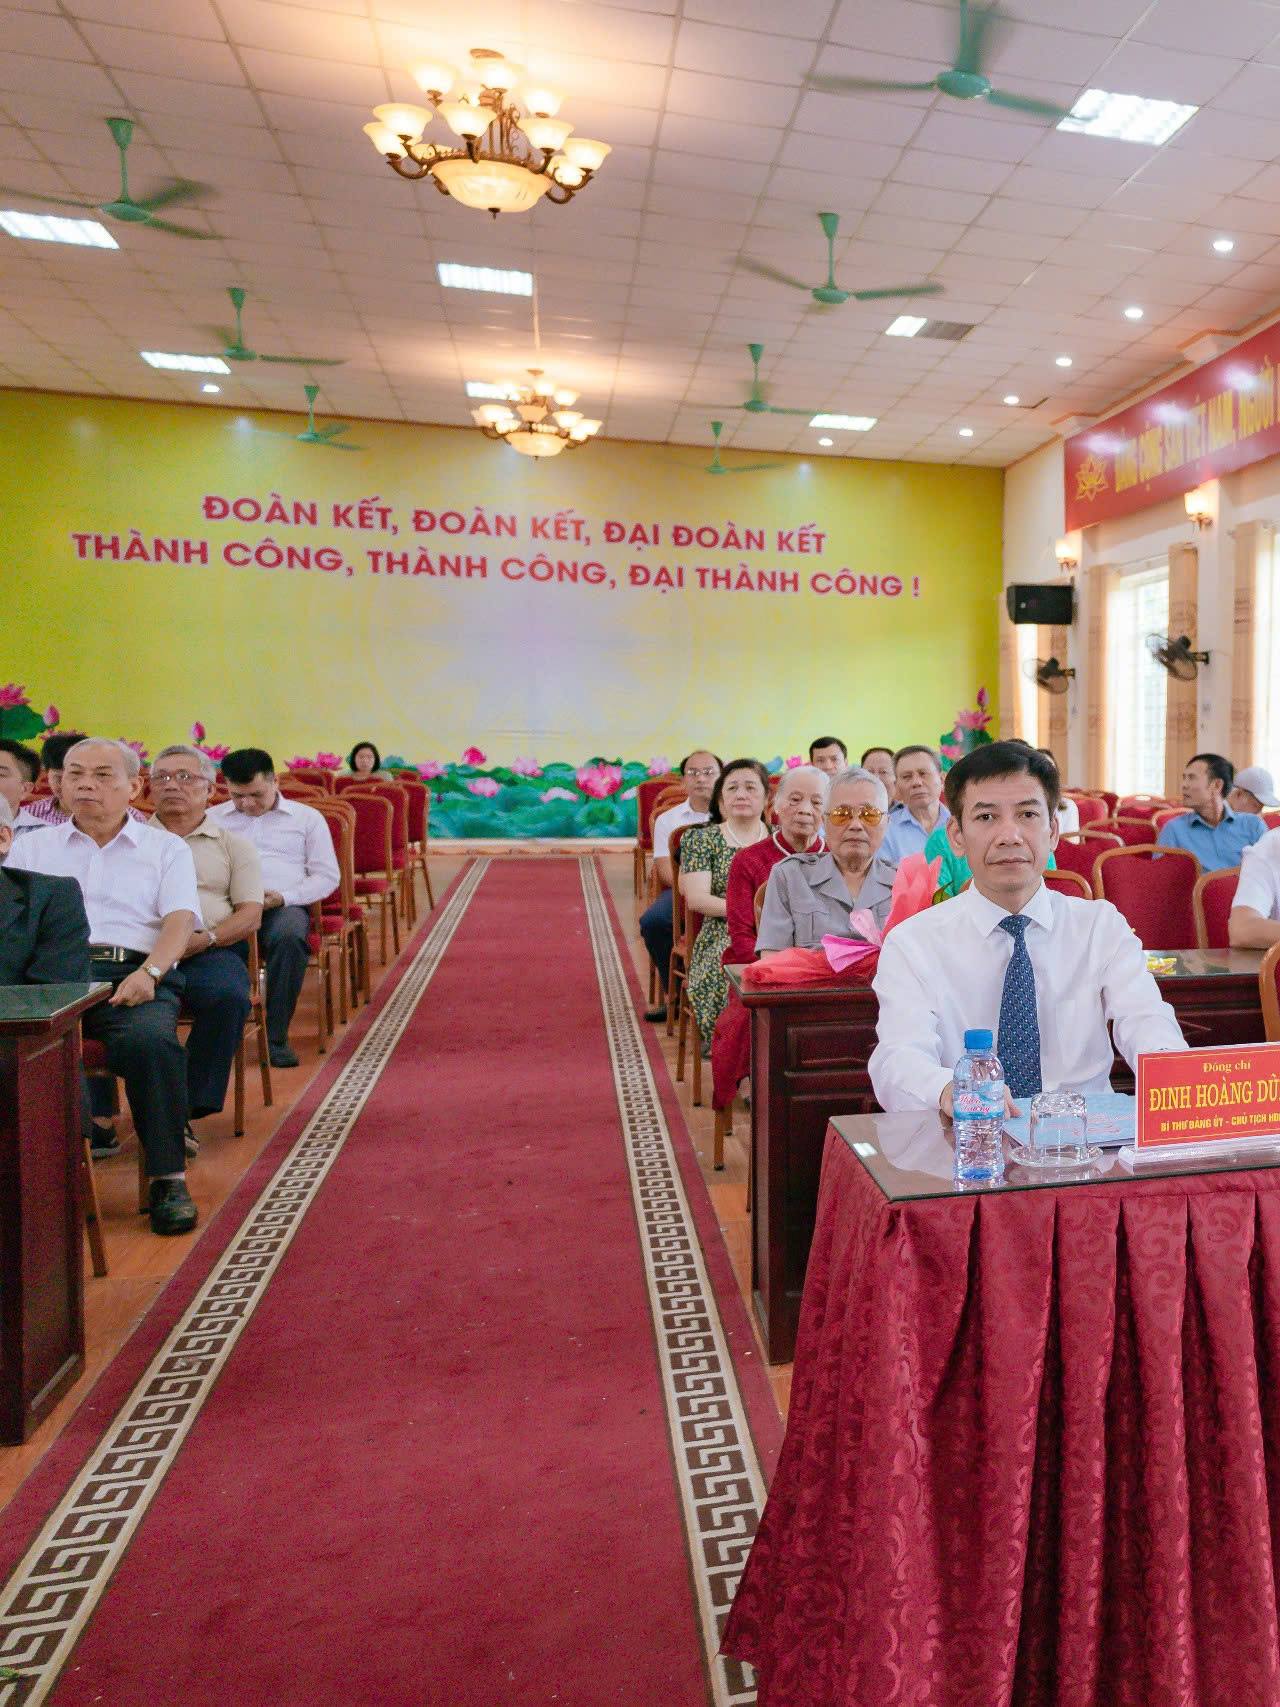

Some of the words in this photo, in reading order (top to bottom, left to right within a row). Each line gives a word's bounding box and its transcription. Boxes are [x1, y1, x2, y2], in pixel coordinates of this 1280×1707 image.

[204, 493, 318, 526] ĐOÀN
[333, 496, 399, 535] KẾT,
[412, 506, 517, 538] ĐOÀN
[531, 509, 591, 546] KẾT,
[603, 520, 660, 551] ĐẠI
[672, 521, 765, 551] ĐOÀN
[778, 524, 826, 555] KẾT
[72, 529, 208, 564] THÀNH
[223, 537, 354, 576] CÔNG,
[367, 546, 488, 579] THÀNH
[501, 553, 616, 589] CÔNG,
[628, 564, 684, 593] ĐẠI
[695, 563, 799, 593] THÀNH
[810, 568, 902, 597] CÔNG
[1149, 1085, 1192, 1112] ĐINH
[1195, 1075, 1253, 1108] HOÀNG
[1172, 1119, 1189, 1131] THƯ
[1249, 1114, 1267, 1126] TỊCH
